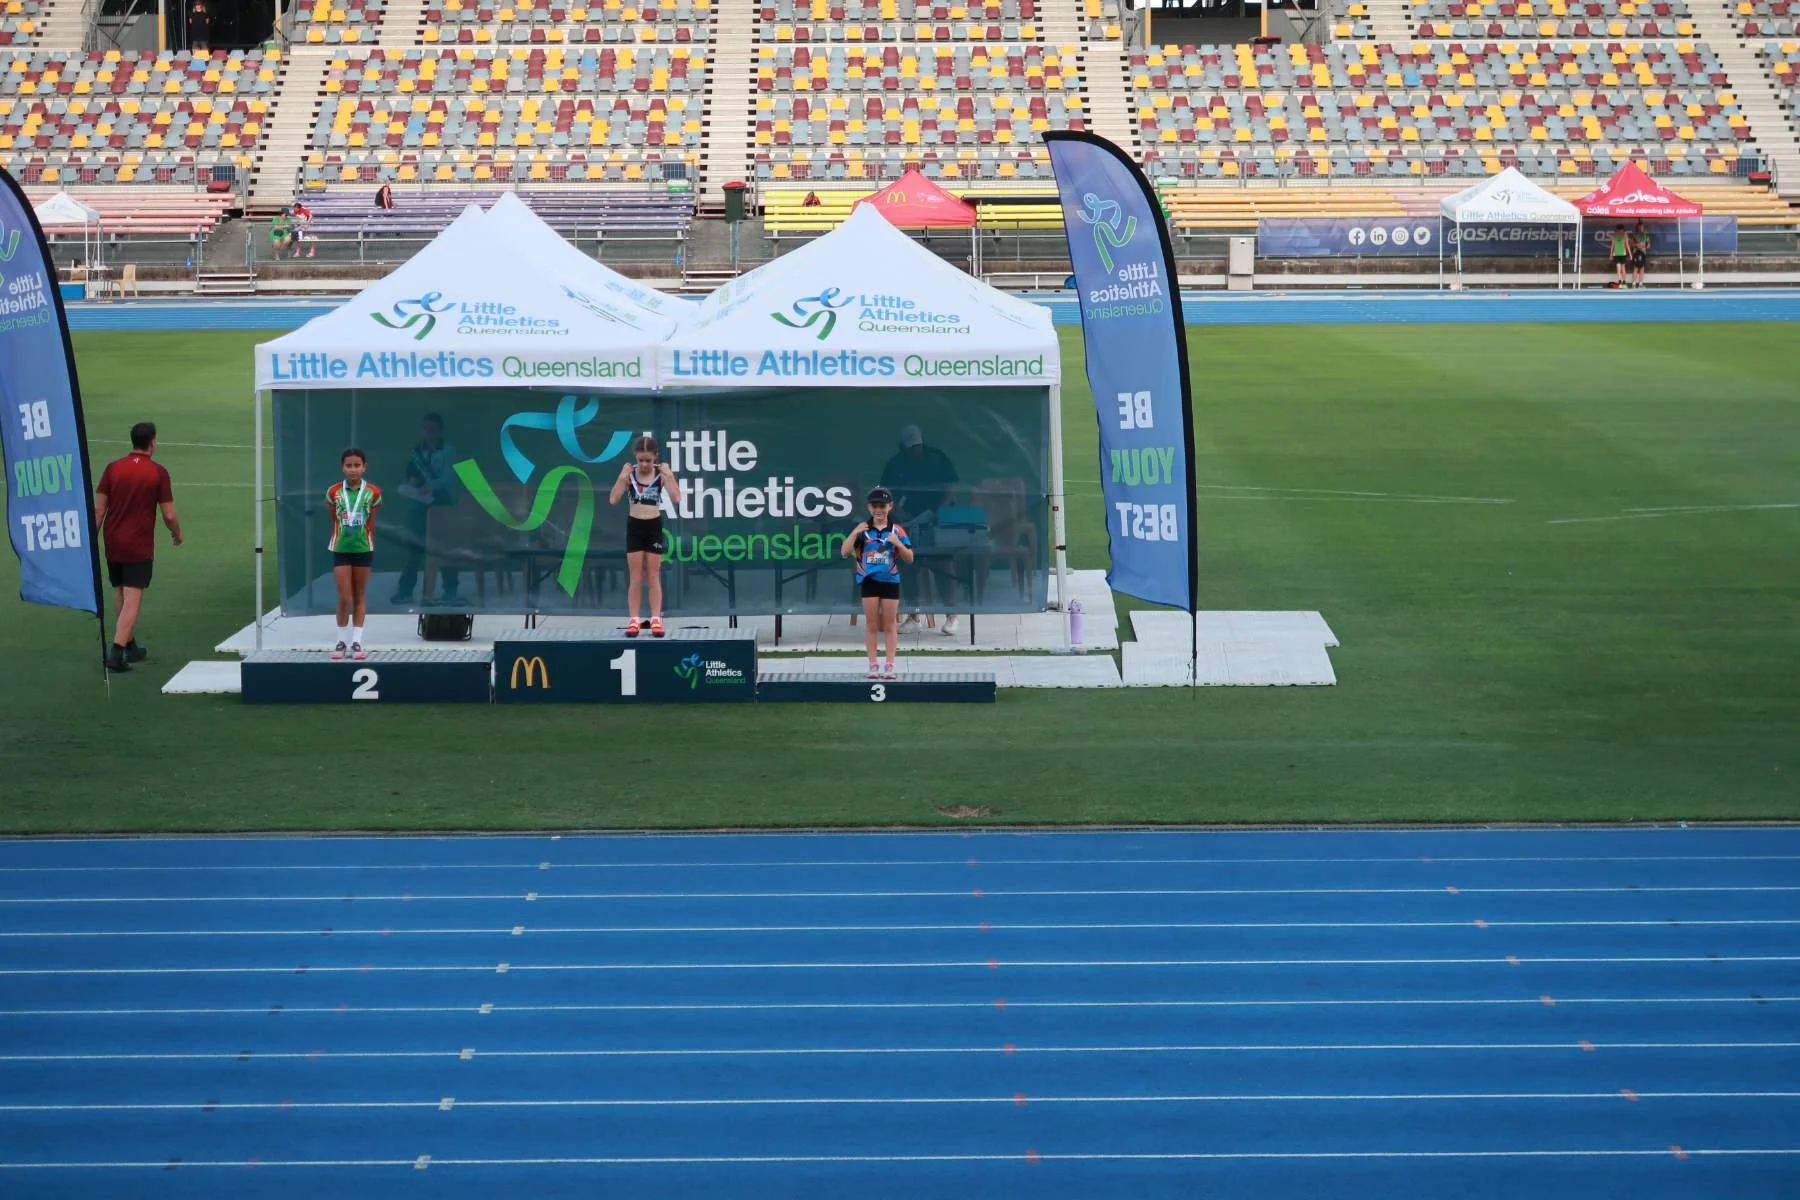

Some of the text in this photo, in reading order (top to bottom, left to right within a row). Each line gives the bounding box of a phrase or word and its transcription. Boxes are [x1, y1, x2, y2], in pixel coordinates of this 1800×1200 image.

[1609, 190, 1670, 206] coles
[1586, 206, 1610, 215] coles
[1447, 228, 1577, 244] @QSACBrisbane
[460, 302, 517, 316] Little
[860, 294, 916, 310] Little
[457, 314, 560, 328] Athletics
[858, 308, 961, 324] Athletics
[456, 325, 569, 336] Queensland
[858, 321, 970, 335] Queensland
[272, 351, 641, 380] Little Athletics Queensland
[673, 349, 1043, 377] Little Athletics Queensland
[643, 430, 758, 473] ittle
[610, 648, 637, 696] 1
[705, 660, 727, 669] Little
[705, 668, 743, 677] Athletics
[351, 668, 379, 700] 2
[870, 683, 886, 702] 3
